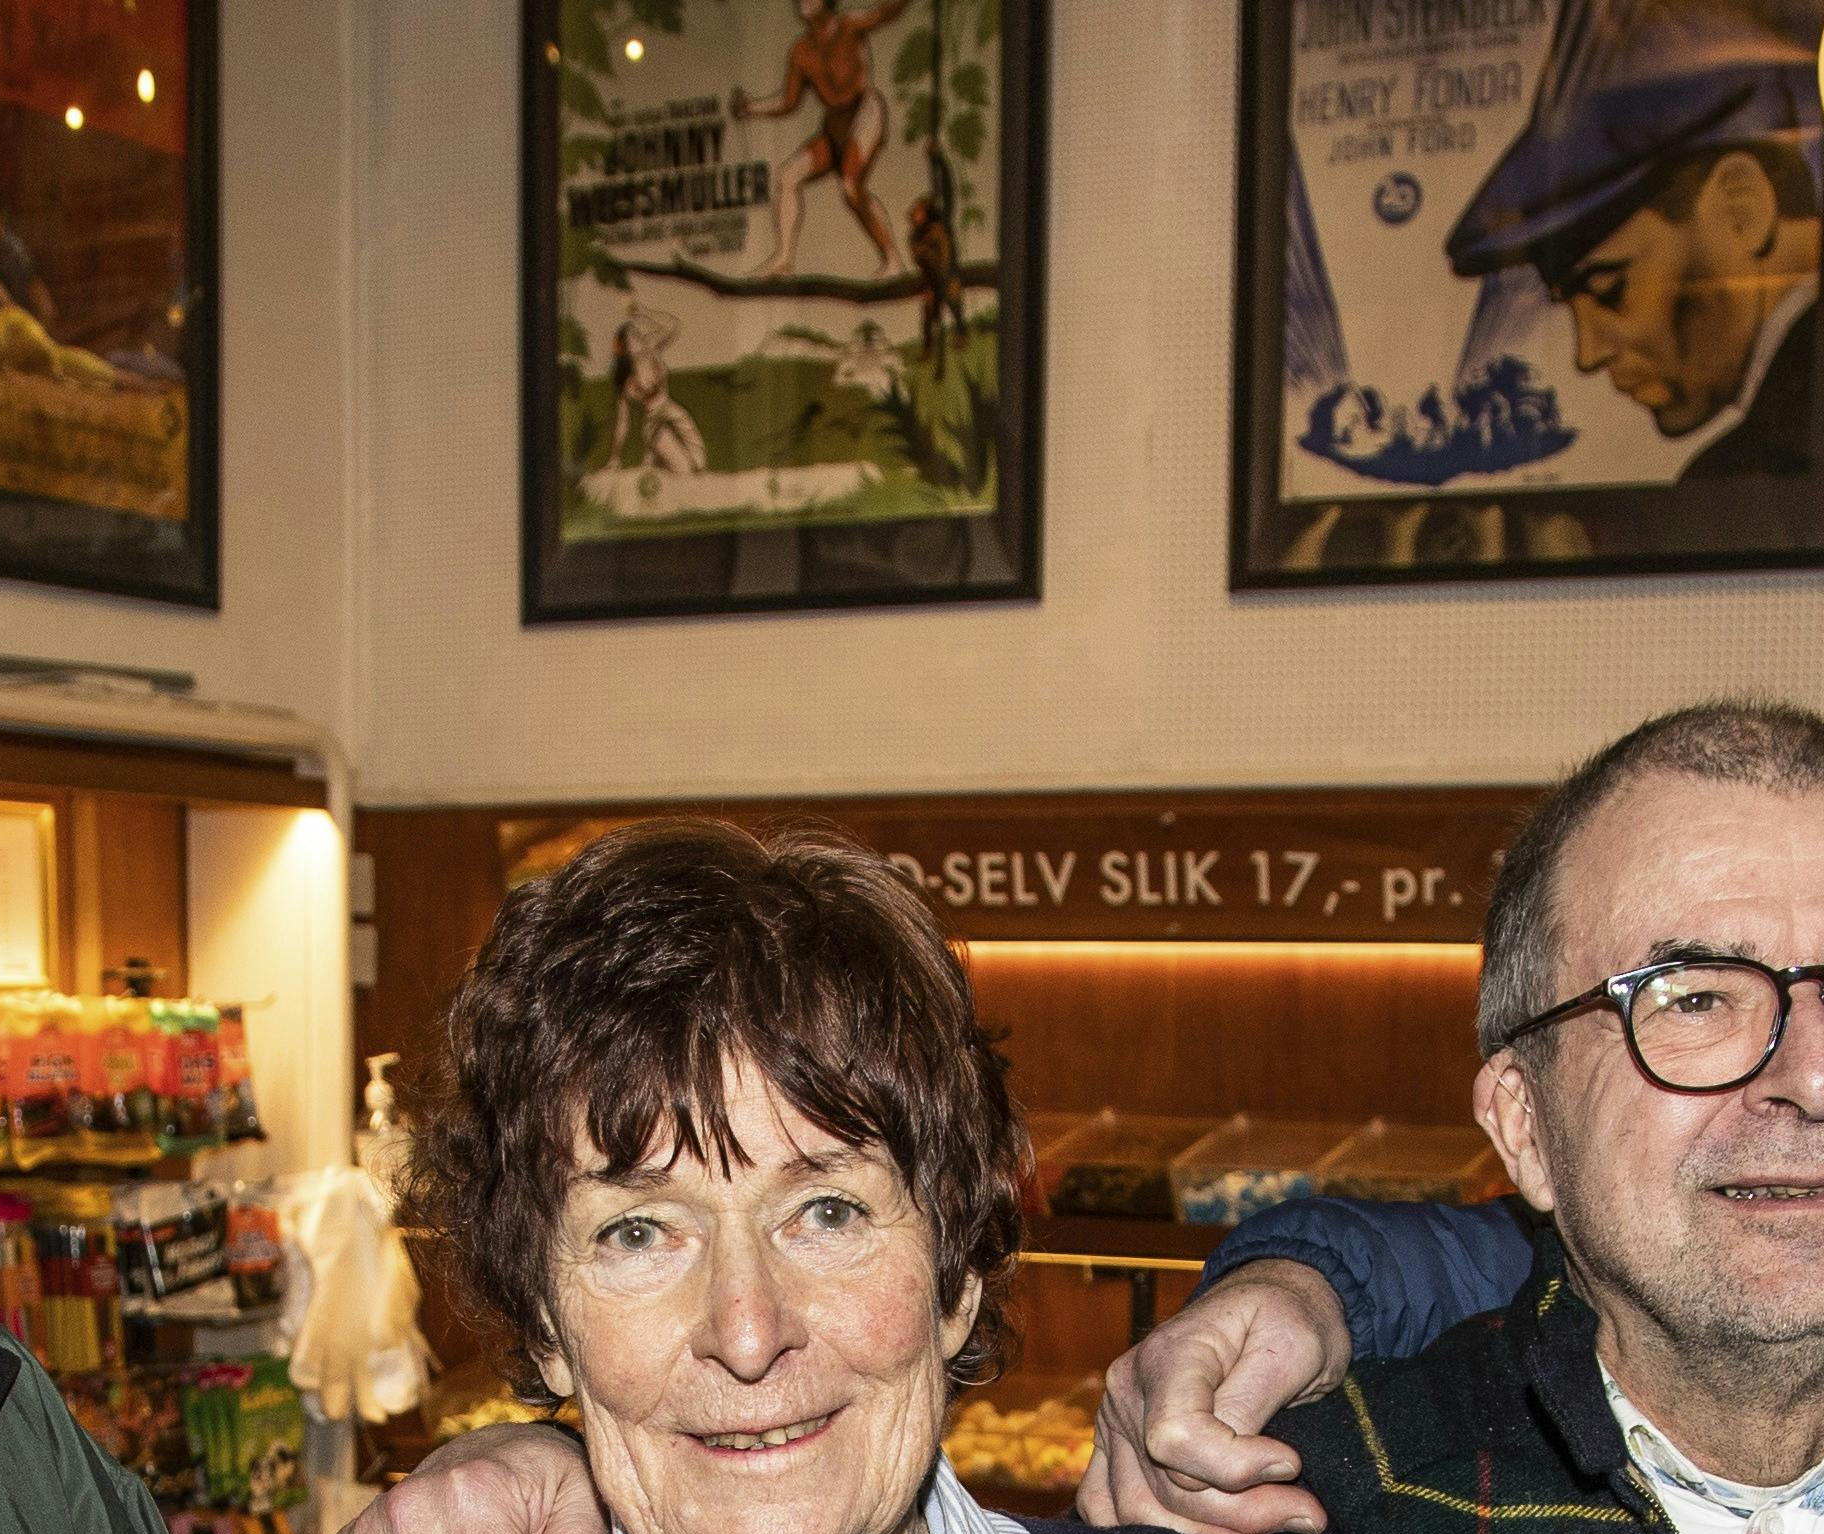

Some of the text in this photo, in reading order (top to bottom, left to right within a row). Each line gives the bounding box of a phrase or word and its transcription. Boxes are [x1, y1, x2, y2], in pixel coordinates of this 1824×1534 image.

[1296, 60, 1523, 124] HENRY FONDA
[604, 121, 725, 175] JOHNNY
[1406, 121, 1477, 154] FORD
[1098, 849, 1223, 908] SLIK
[1249, 849, 1362, 917] 17,-
[1381, 866, 1464, 922] pr.
